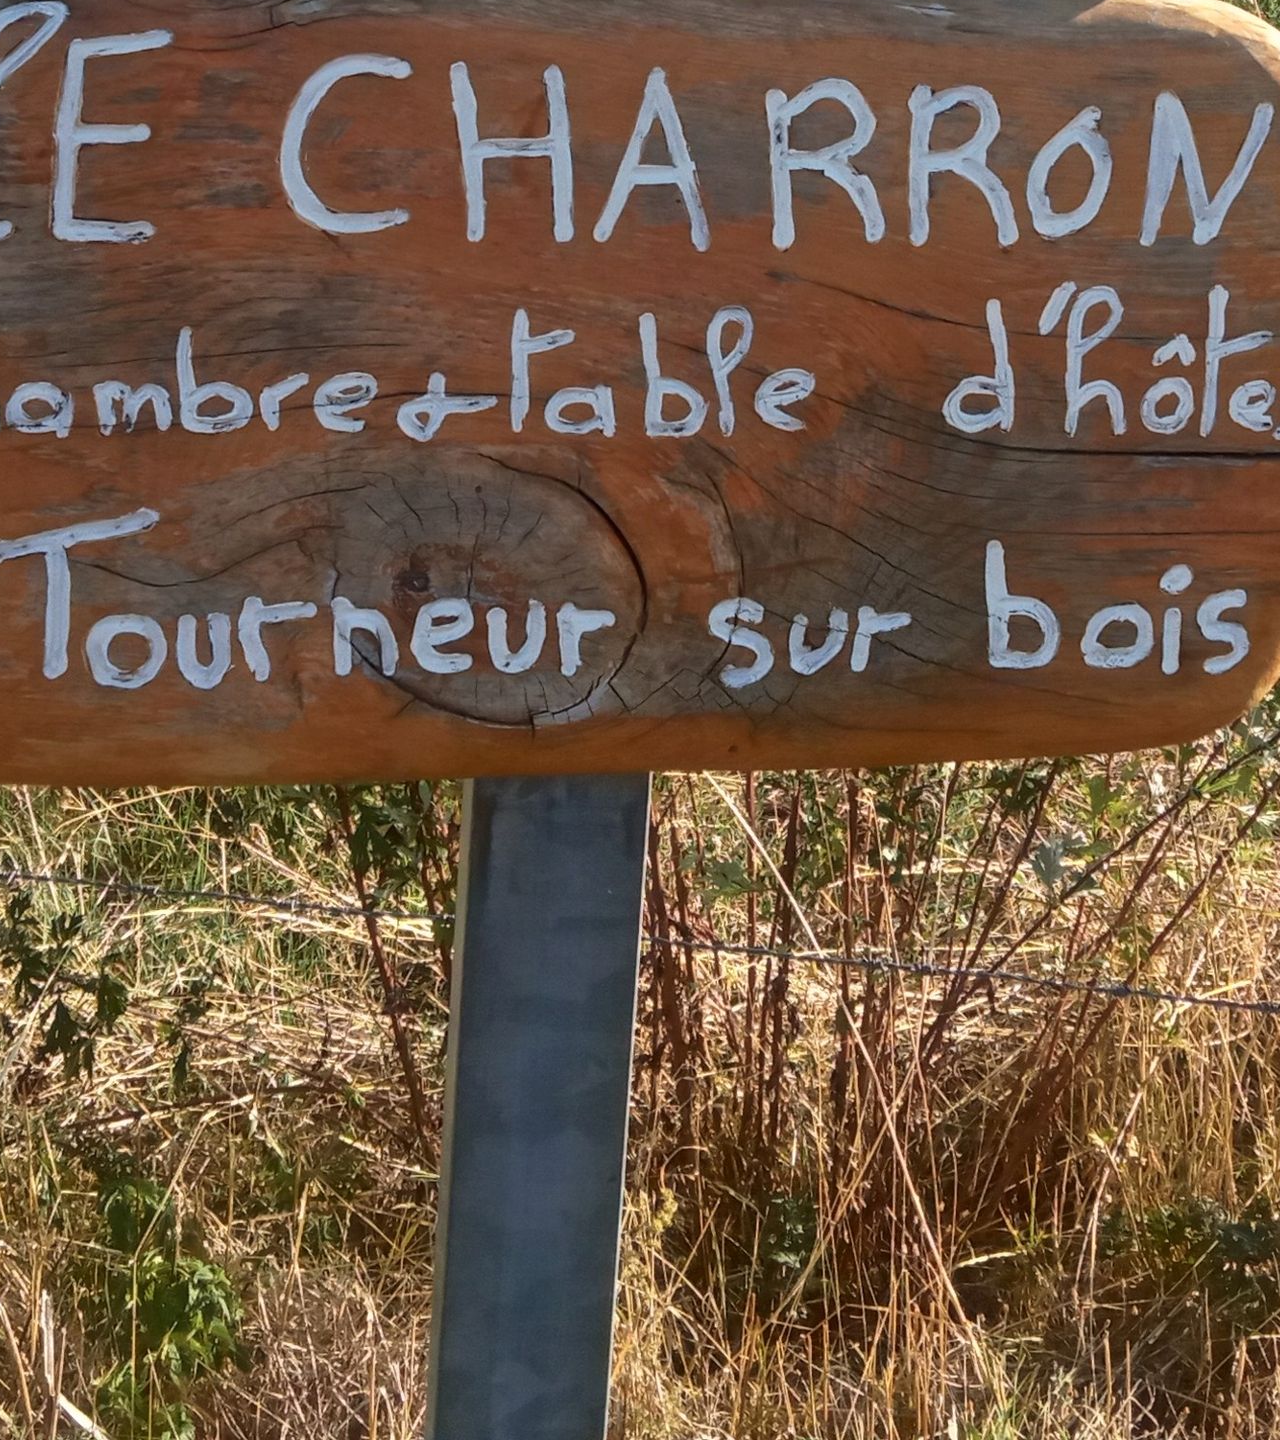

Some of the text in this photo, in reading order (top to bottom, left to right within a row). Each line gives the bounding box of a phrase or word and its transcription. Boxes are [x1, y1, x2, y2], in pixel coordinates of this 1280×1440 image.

[280, 55, 1275, 252] CHARRON
[509, 307, 817, 438] table
[709, 596, 914, 690] sur
[987, 540, 1250, 676] bois
